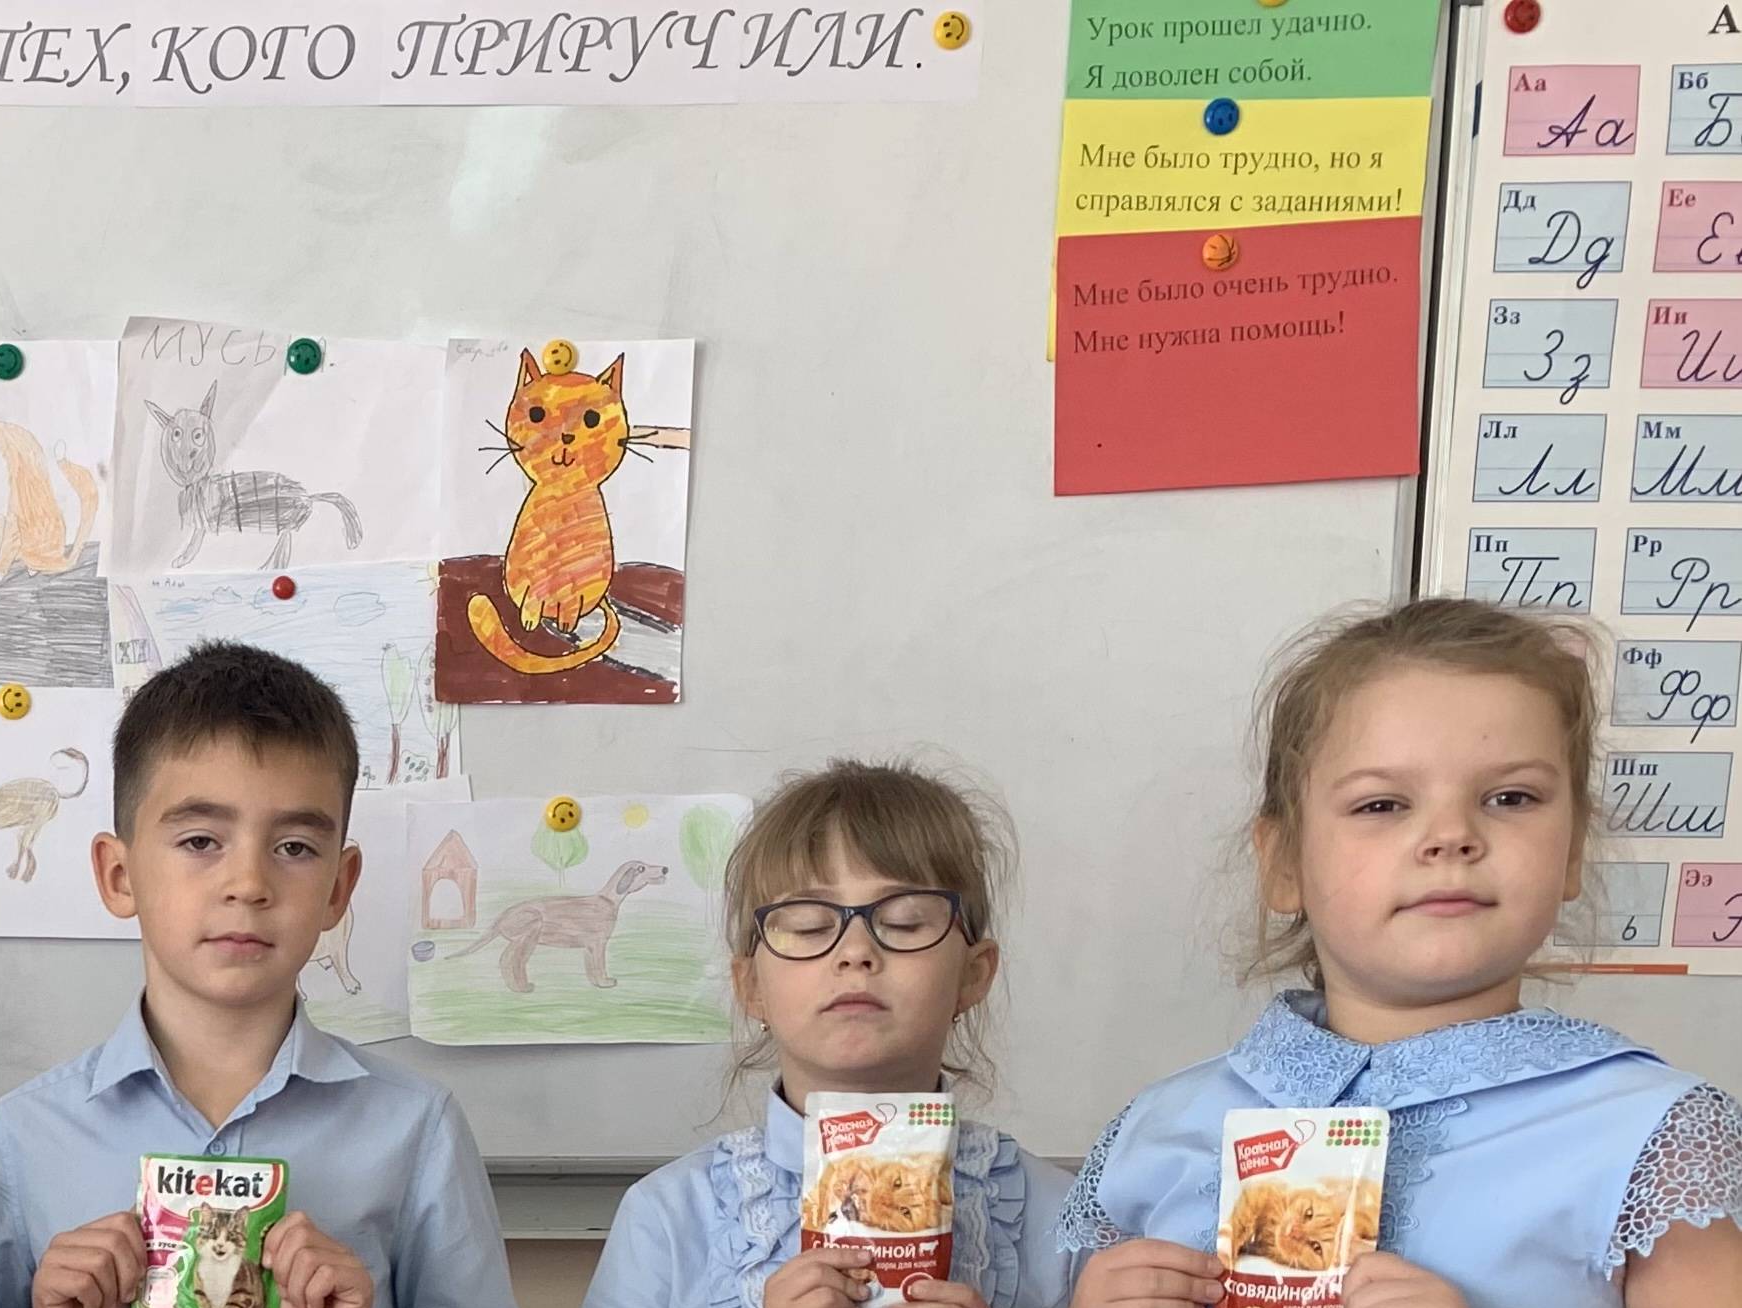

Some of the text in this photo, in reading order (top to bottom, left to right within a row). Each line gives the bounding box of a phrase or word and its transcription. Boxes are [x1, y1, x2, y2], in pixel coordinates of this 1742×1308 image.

[1086, 13, 1372, 45] Урок прошел удачно.
[151, 23, 356, 95] КОГО
[1084, 58, 1312, 90] Я доволен собой.
[1514, 73, 1547, 92] Аа
[1677, 72, 1709, 90] Бб
[1694, 92, 1742, 147] Б
[1080, 143, 1383, 174] Мне было трудно, но я
[1076, 188, 1403, 217] справлялся с заданиями!
[1503, 190, 1537, 213] Дд
[1668, 188, 1696, 207] Ее
[1697, 212, 1742, 265] Е
[1073, 265, 1399, 307] Мне было очень трудно.
[1493, 306, 1521, 325] Зз
[1653, 306, 1688, 325] Ии
[1073, 310, 1346, 354] Мне нужна помощь!
[1483, 420, 1518, 439] Лл
[1641, 421, 1682, 439] Мм
[1474, 534, 1509, 553] Пп
[1632, 535, 1663, 557] Рр
[1622, 646, 1662, 669] Фф
[1612, 758, 1658, 776] Шш
[1684, 868, 1713, 888] Ээ
[1237, 1137, 1290, 1160] Красная
[1239, 1156, 1269, 1173] цена
[158, 1165, 264, 1198] kitekat
